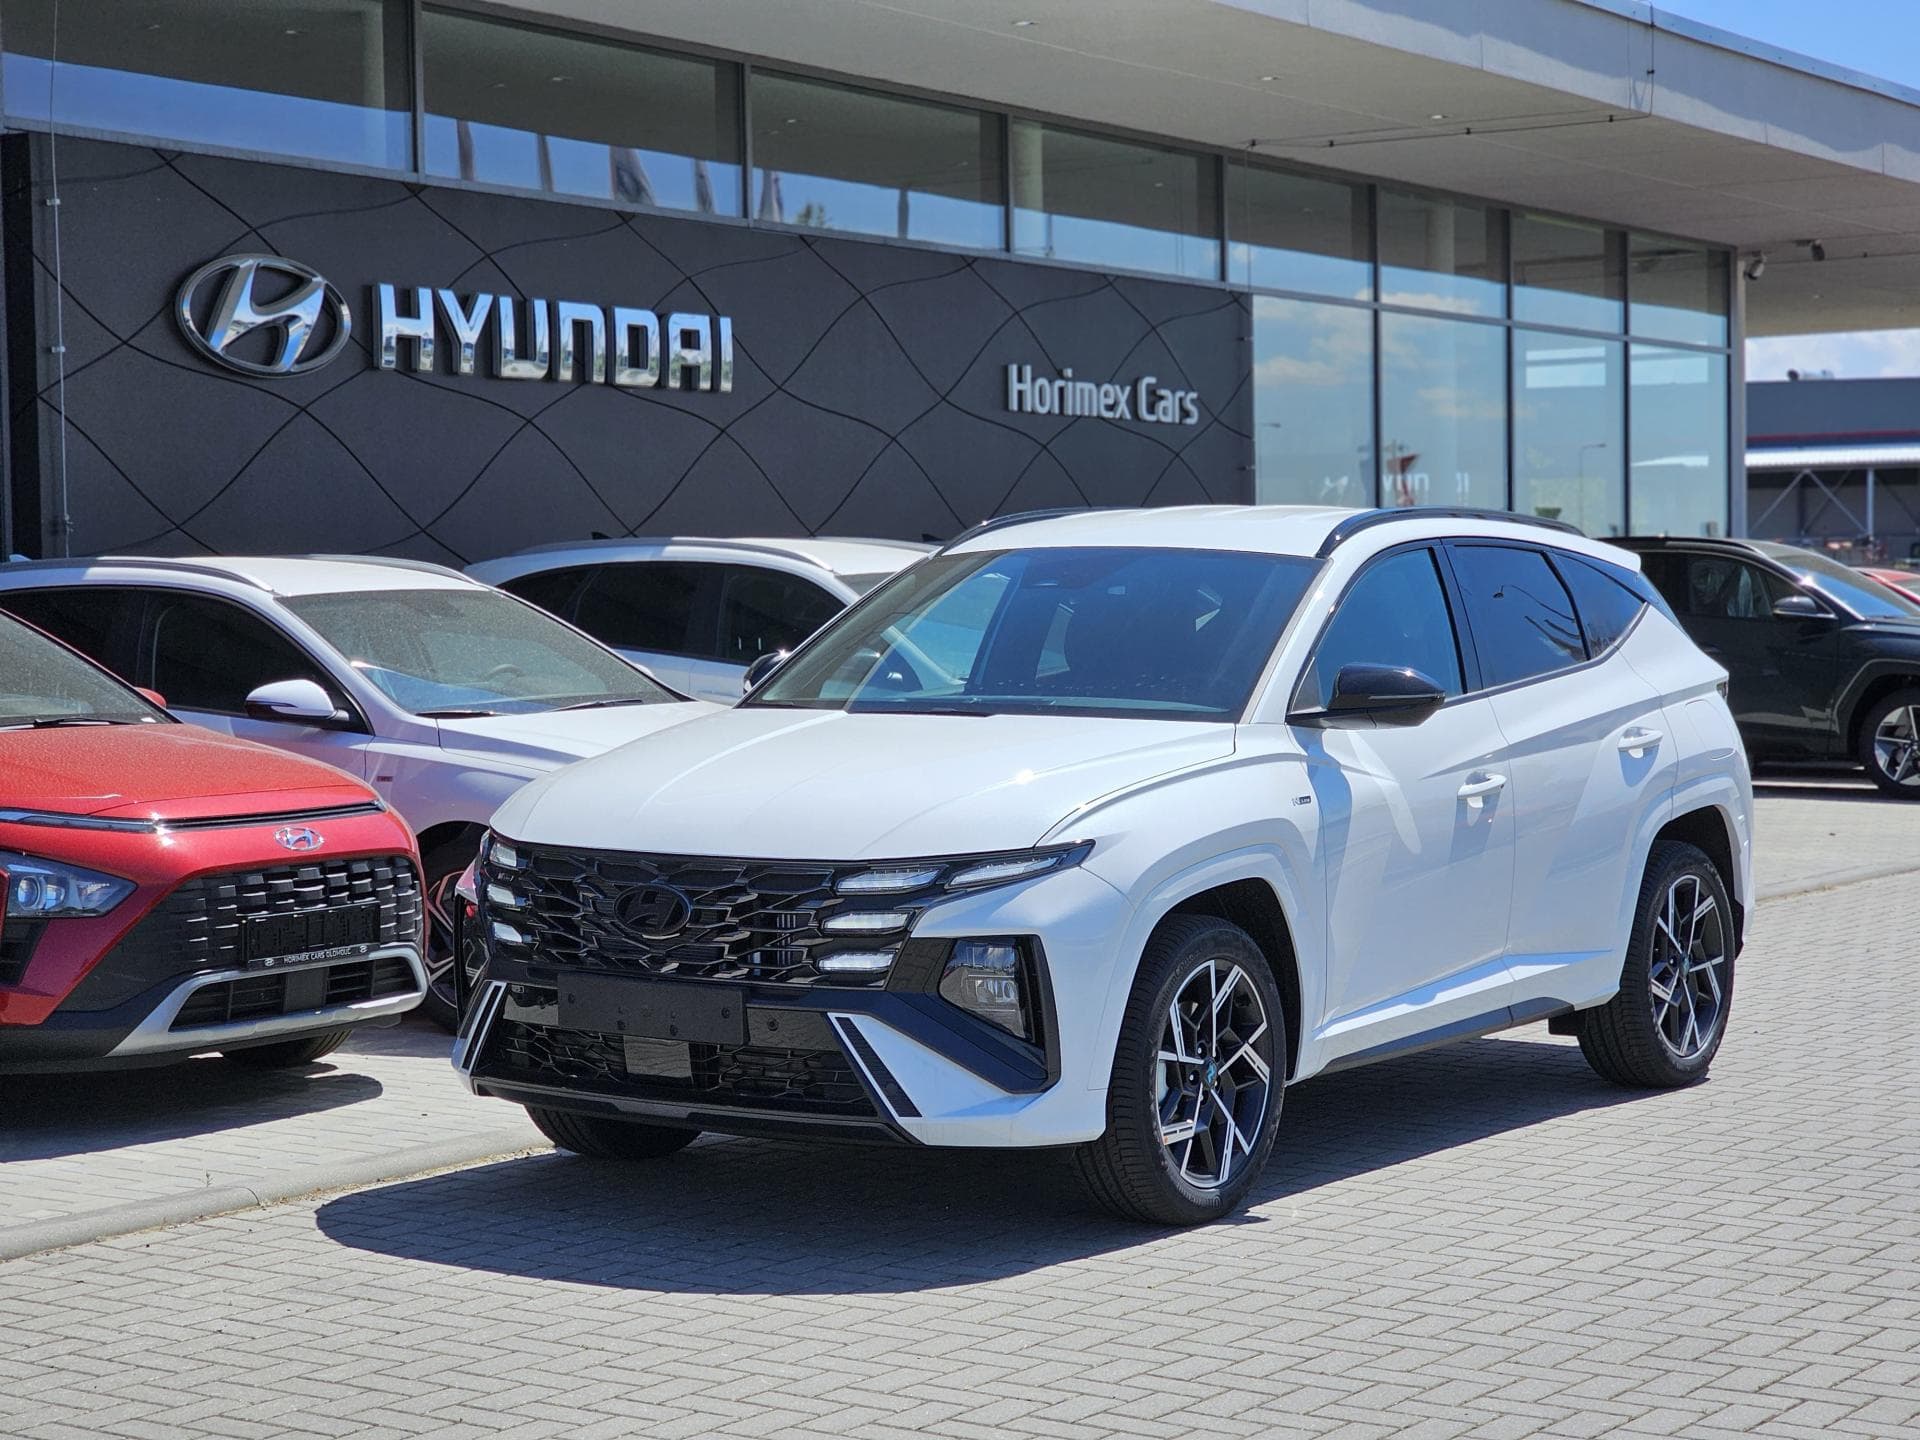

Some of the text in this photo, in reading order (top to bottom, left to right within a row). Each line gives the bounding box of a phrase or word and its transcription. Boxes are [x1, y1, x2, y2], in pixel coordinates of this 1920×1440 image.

[372, 282, 733, 392] HYUNDAI
[1007, 363, 1199, 425] Horimex Cars
